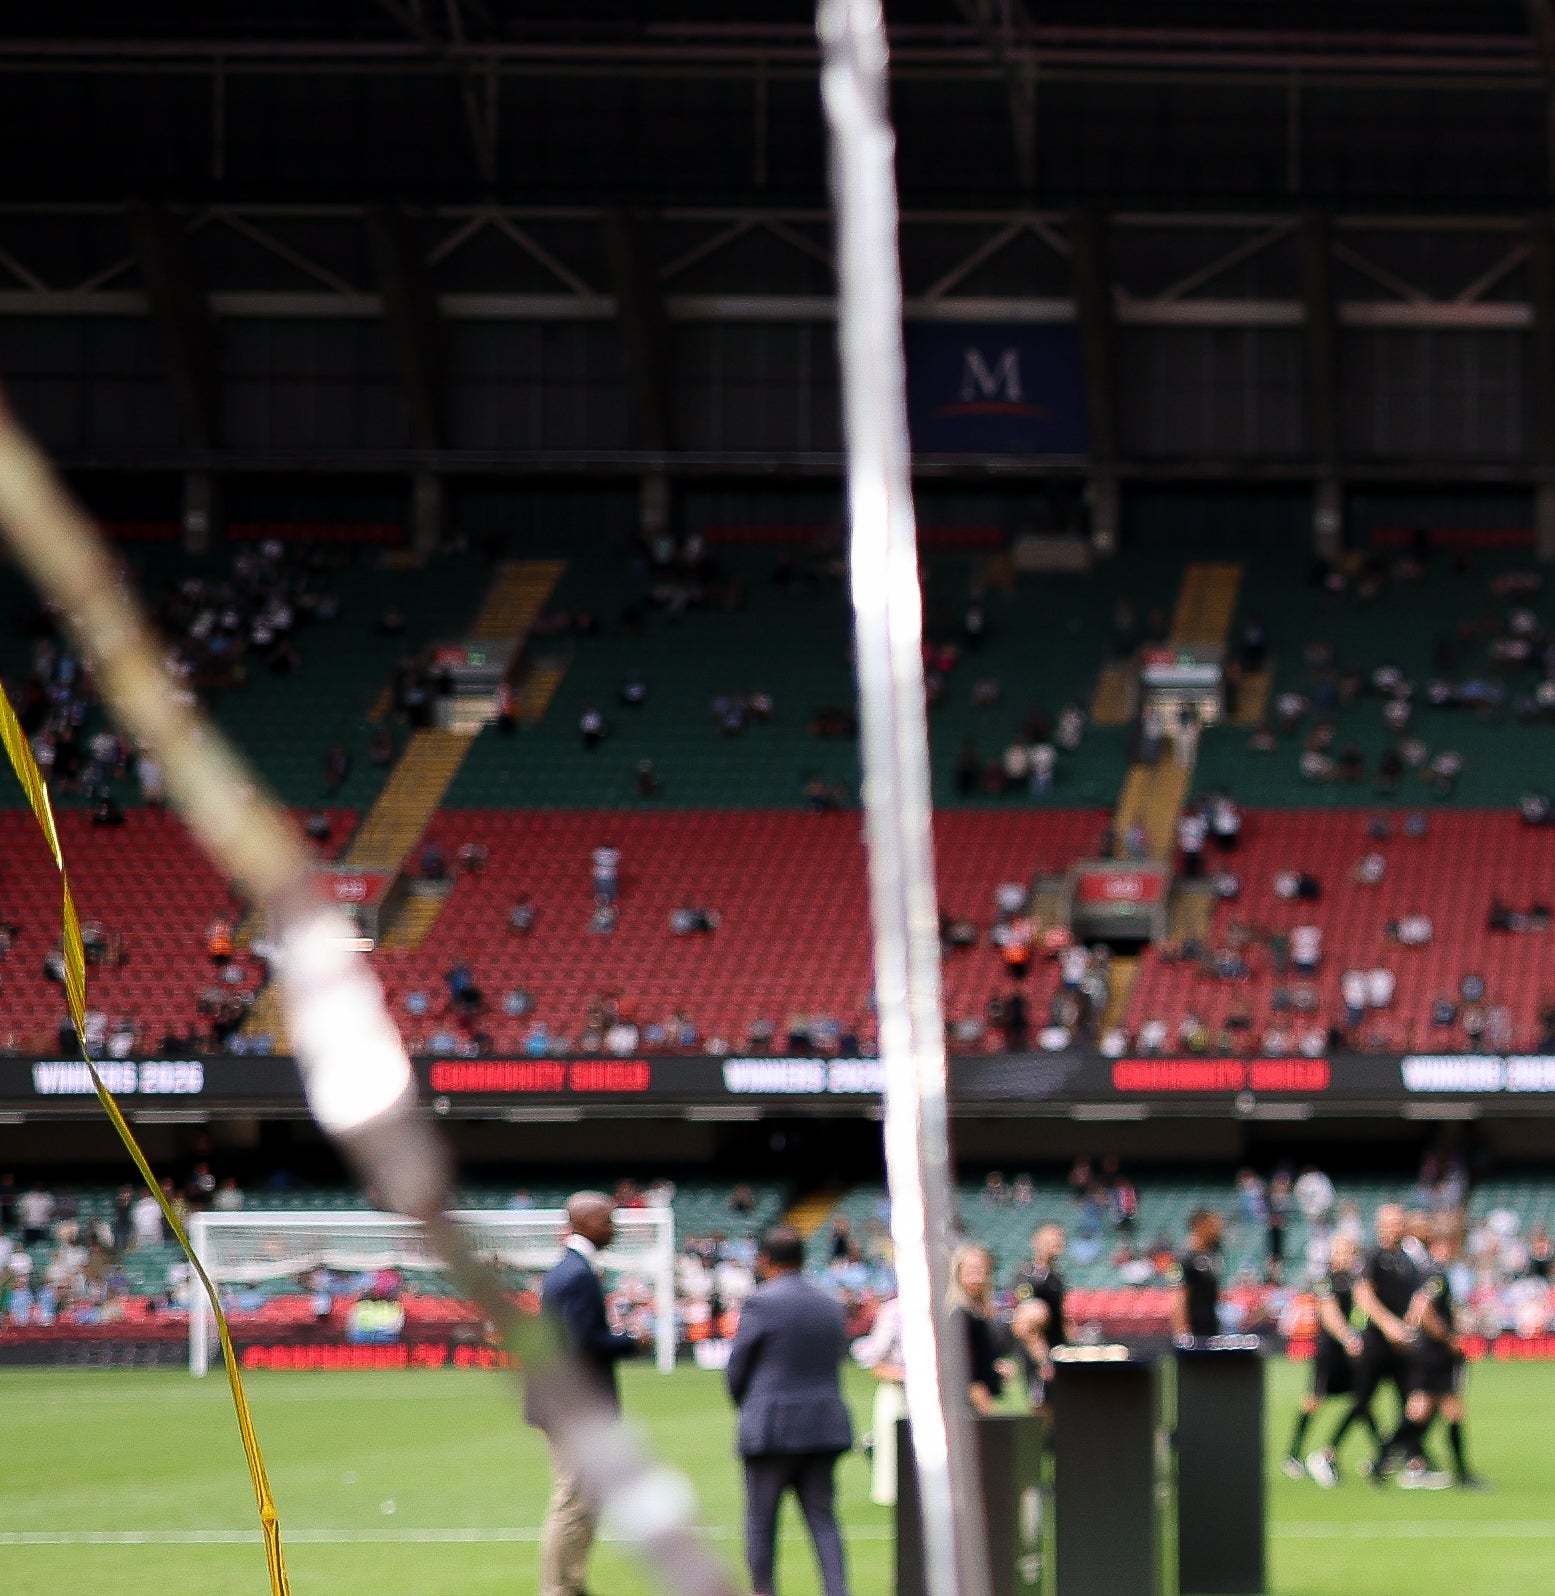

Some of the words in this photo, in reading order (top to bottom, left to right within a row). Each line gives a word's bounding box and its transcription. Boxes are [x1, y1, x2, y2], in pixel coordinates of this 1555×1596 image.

[958, 346, 1026, 401] M
[33, 1060, 137, 1094] WINNERS
[430, 1060, 566, 1092] COMMUNITY
[568, 1060, 650, 1092] SHIELD
[723, 1058, 826, 1093] WINNERS
